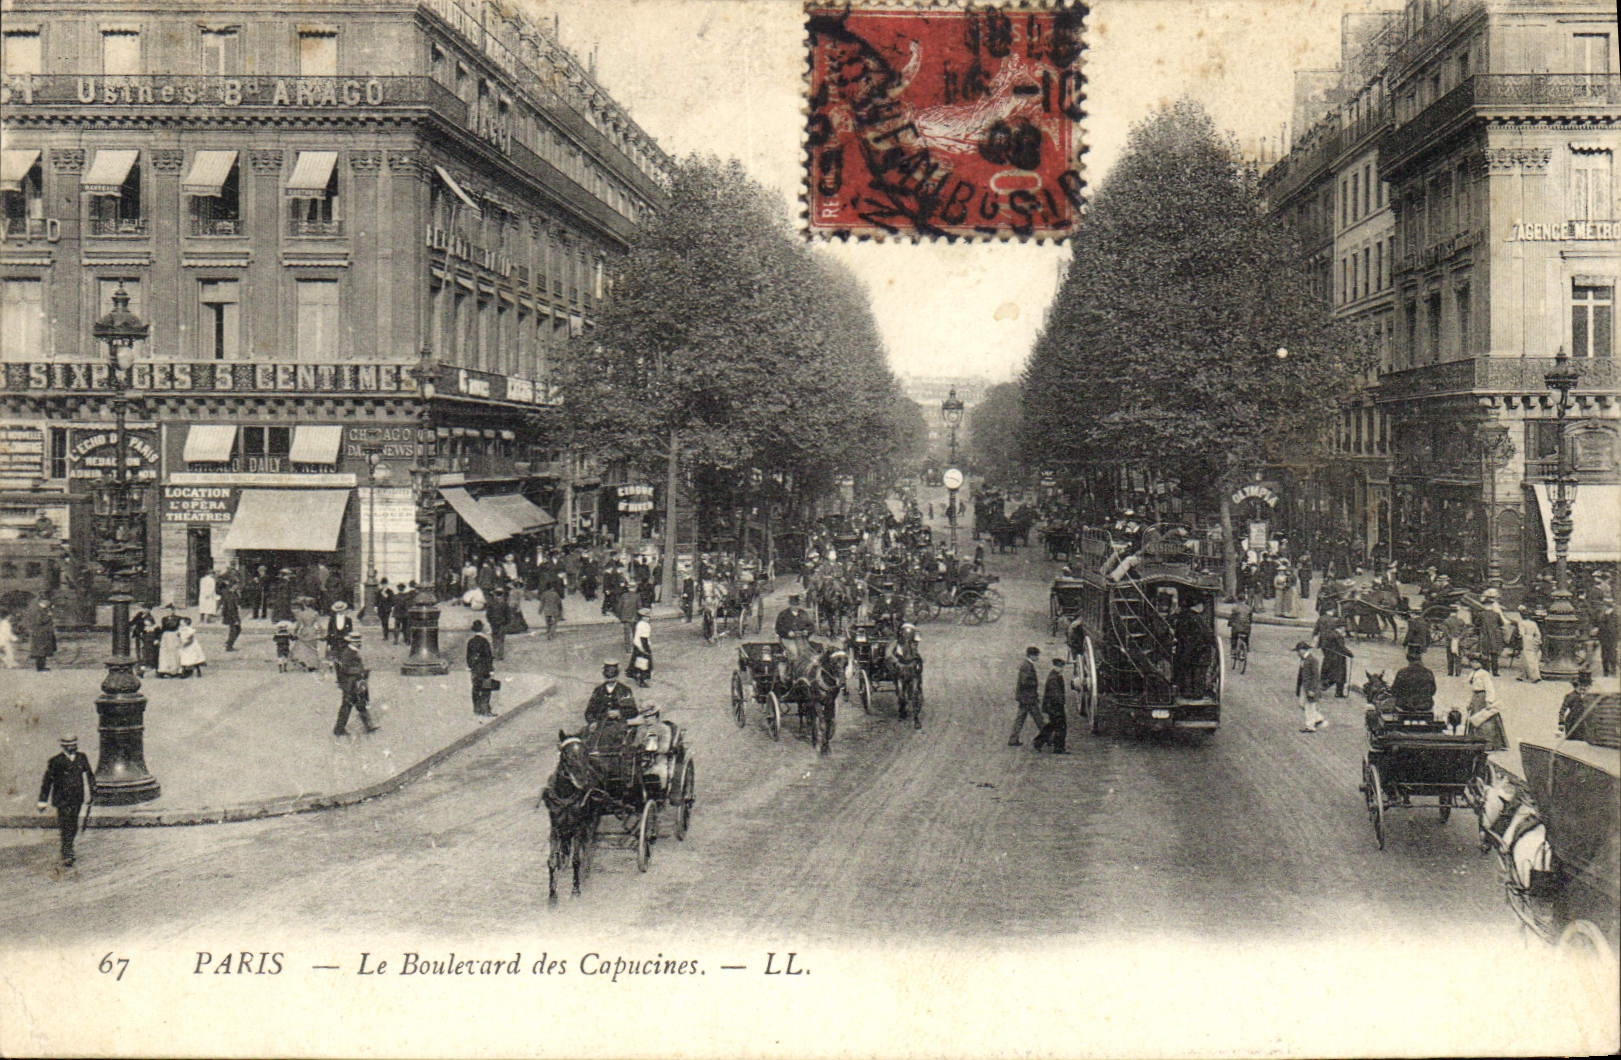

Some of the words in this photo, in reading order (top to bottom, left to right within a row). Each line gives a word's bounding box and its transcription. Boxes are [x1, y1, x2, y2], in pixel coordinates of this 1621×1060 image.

[77, 76, 198, 104] Usines
[272, 79, 384, 106] ARAGO
[1517, 222, 1569, 241] AGENCE
[215, 364, 234, 390] 5
[255, 364, 418, 391] CENTIMES
[249, 456, 282, 473] DAILY
[164, 487, 231, 498] LOCATION
